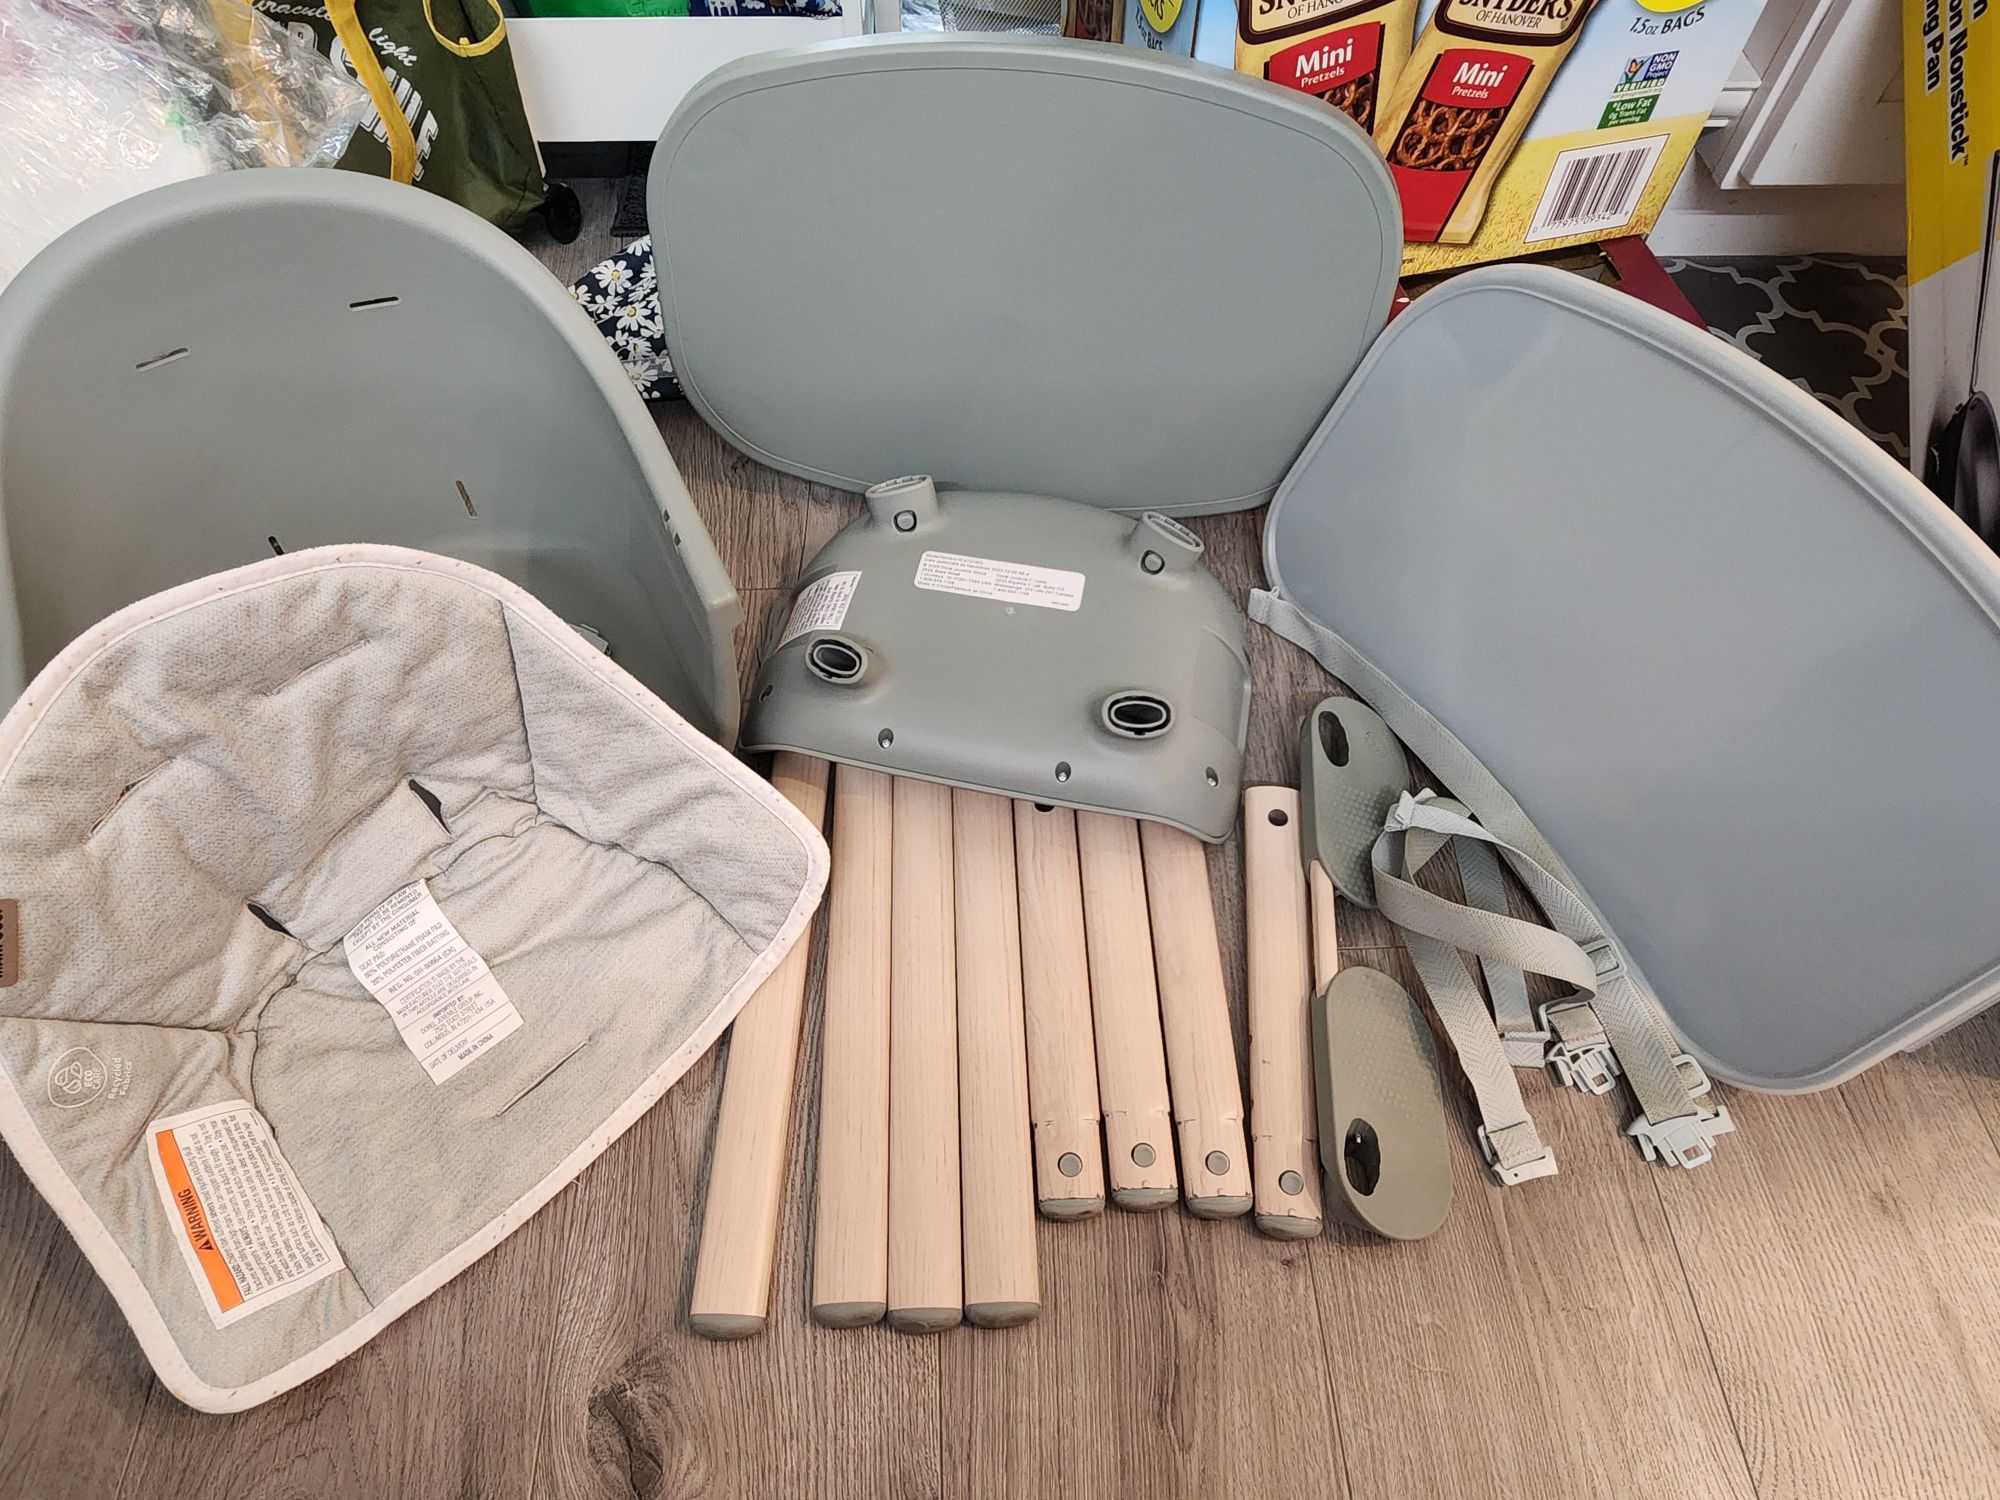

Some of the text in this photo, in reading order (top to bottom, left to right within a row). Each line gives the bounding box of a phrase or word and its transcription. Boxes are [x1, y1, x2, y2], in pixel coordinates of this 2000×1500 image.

[1288, 6, 1306, 18] OF
[1476, 10, 1542, 29] OF HANOVER
[1660, 6, 1706, 34] BAGS
[368, 27, 417, 66] light
[1295, 38, 1354, 78] Mini
[1650, 62, 1672, 72] GMO
[1653, 53, 1676, 63] NON
[1926, 32, 1944, 90] Pan
[1300, 66, 1345, 88] Pretzels
[1452, 62, 1509, 88] Mini
[1617, 79, 1665, 92] VERIFIED
[1452, 86, 1489, 100] Pretzels
[1636, 98, 1652, 108] Fat
[390, 909, 419, 931] MATERIAL
[458, 1047, 472, 1059] MADE
[477, 1033, 493, 1046] CHINA
[84, 1070, 92, 1088] ECO
[108, 1057, 122, 1100] Recycled
[178, 1188, 206, 1242] WARNING
